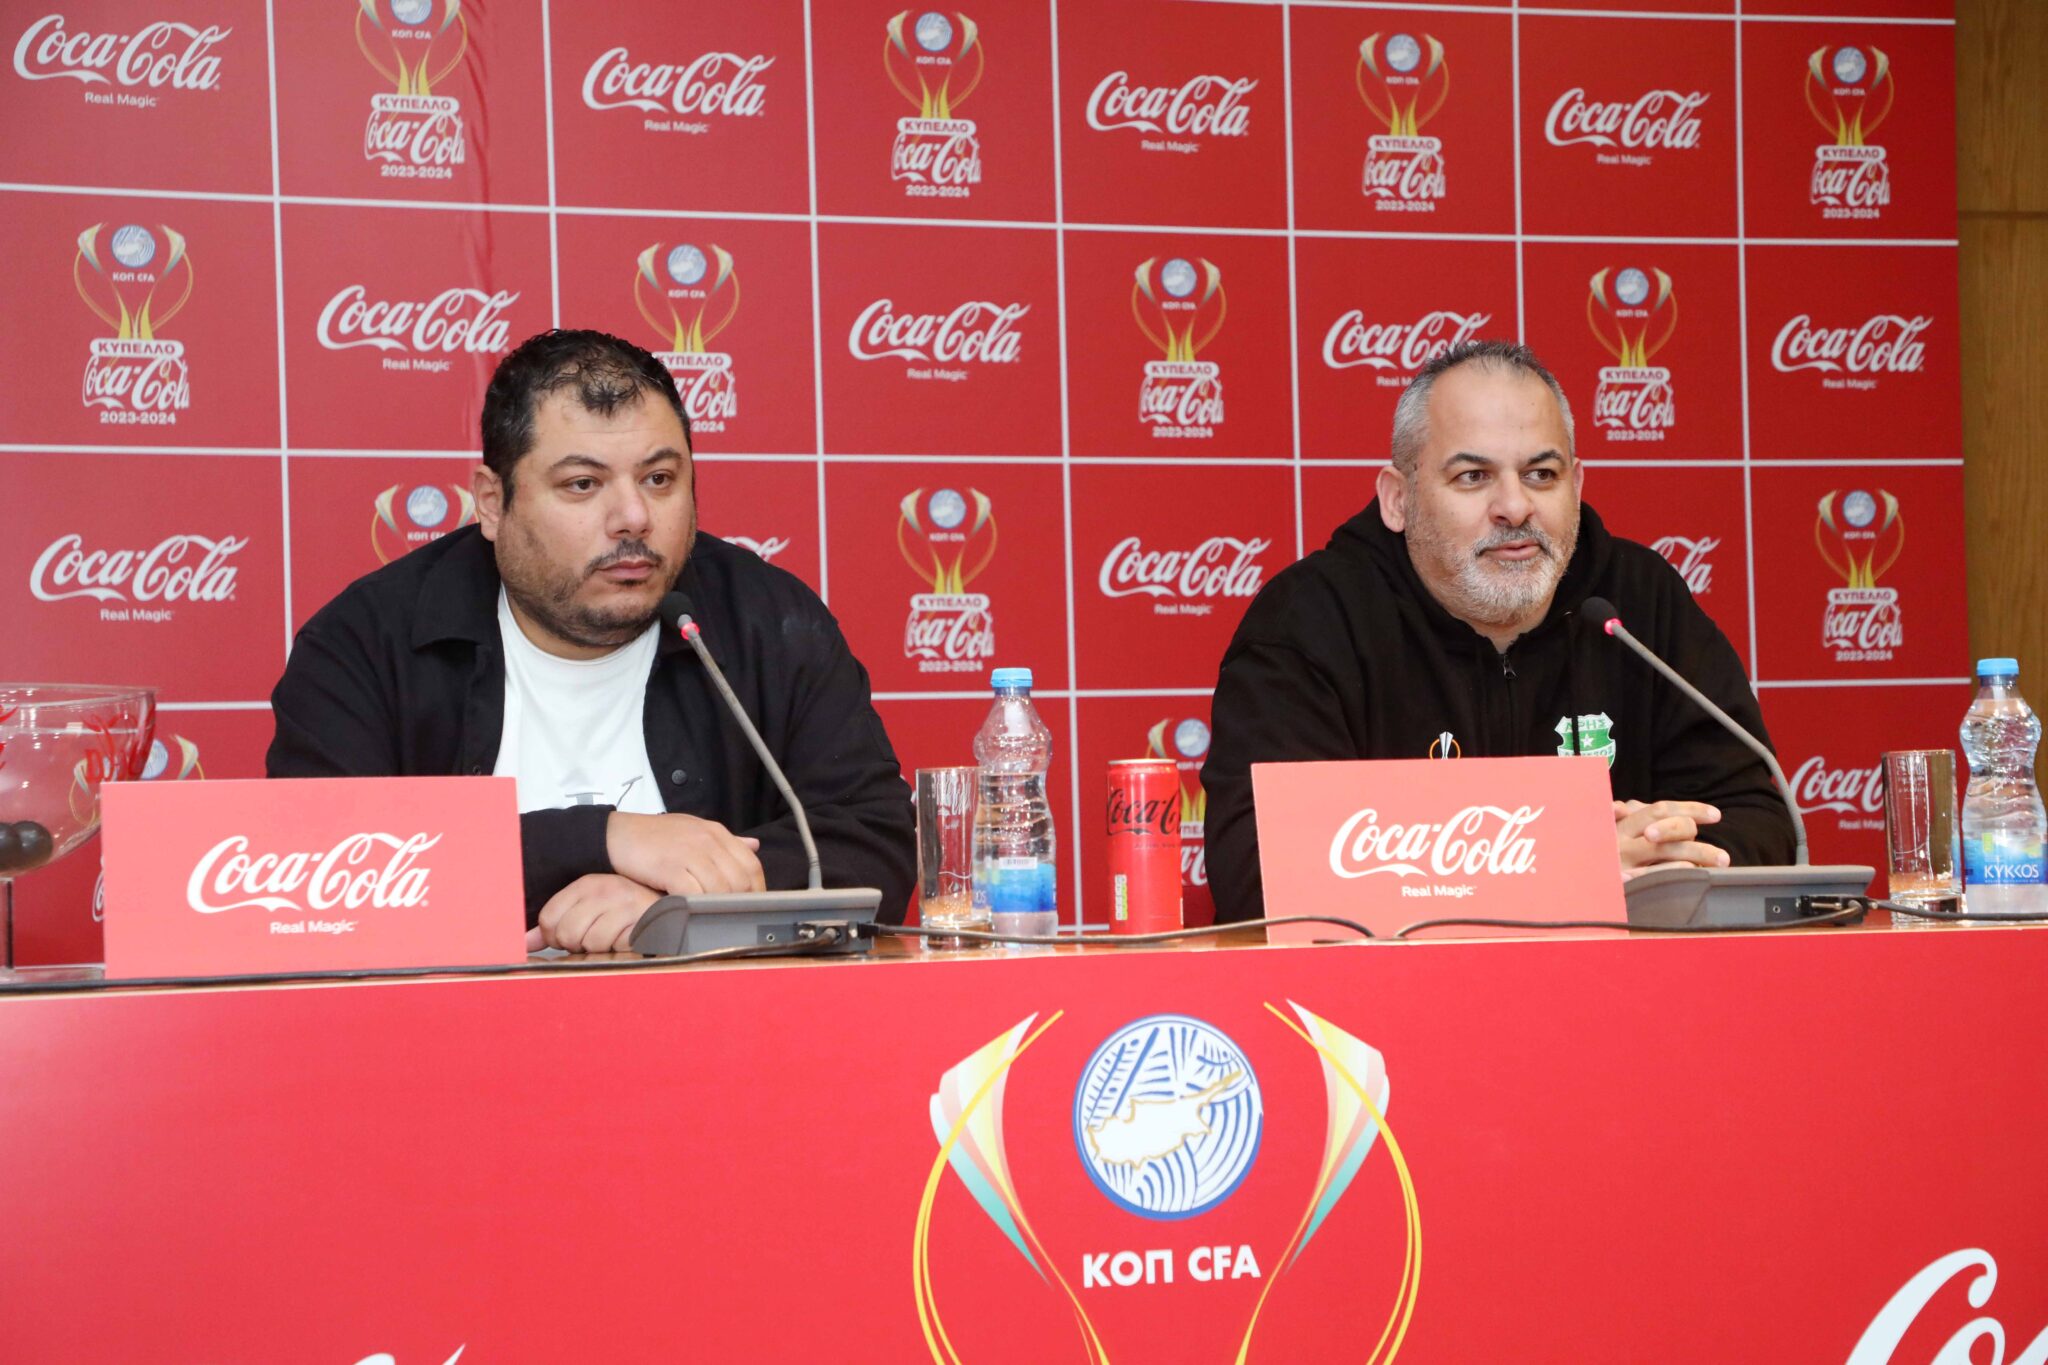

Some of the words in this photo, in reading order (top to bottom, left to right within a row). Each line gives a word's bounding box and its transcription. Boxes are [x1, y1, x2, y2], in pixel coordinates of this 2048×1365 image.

[14, 15, 232, 90] Coca-Cola
[582, 47, 774, 116] Coca-Cola
[85, 92, 113, 104] Real
[117, 94, 155, 108] Magic
[1086, 71, 1257, 136] Coca-Cola
[1545, 88, 1708, 148] Coca-Cola
[644, 120, 671, 131] Real
[673, 121, 707, 134] Magic
[1142, 140, 1165, 150] Real
[1167, 141, 1198, 153] Magic
[1597, 154, 1620, 164] Real
[1621, 155, 1650, 166] Magic
[381, 165, 452, 178] 2023-2024
[906, 185, 969, 197] 2023-2024
[1376, 200, 1435, 211] 2023-2024
[1823, 208, 1880, 218] 2023-2024
[317, 285, 519, 352] Coca-Cola
[849, 299, 1028, 362] Coca-Cola
[1323, 310, 1491, 370] Coca-Col
[1772, 315, 1931, 372] Coca-Cola
[383, 358, 410, 370] Real
[413, 359, 449, 372] Magic
[907, 368, 932, 379] Real
[934, 369, 966, 381] Magic
[1377, 376, 1400, 386] Real
[1823, 379, 1845, 388] Real
[1846, 379, 1875, 390] Magic
[101, 411, 176, 424] 2023-2024
[1153, 426, 1213, 438] 2023-2024
[1607, 430, 1664, 440] 2023-2024
[30, 534, 248, 601] Coca-Cola
[1099, 537, 1270, 597] Coca-Cola
[100, 609, 129, 620] Real
[133, 609, 171, 622] Magic
[1154, 604, 1178, 614] Real
[1180, 605, 1211, 616] Magic
[1836, 650, 1893, 661] 2023-2024
[919, 660, 983, 672] 2023-2024
[1790, 756, 1883, 814] Coca-C
[1107, 789, 1181, 836] Coca-C
[1839, 820, 1862, 829] Real
[1862, 820, 1884, 832] Mag
[1329, 806, 1544, 878] Coca-Cola
[187, 833, 442, 913] Coca-Cola
[1402, 886, 1431, 896] Real
[1434, 885, 1473, 898] Magic
[270, 921, 305, 933] Real
[308, 920, 354, 934] Magic
[1083, 1250, 1173, 1288] ΚΟΠ
[1188, 1245, 1261, 1281] CFA
